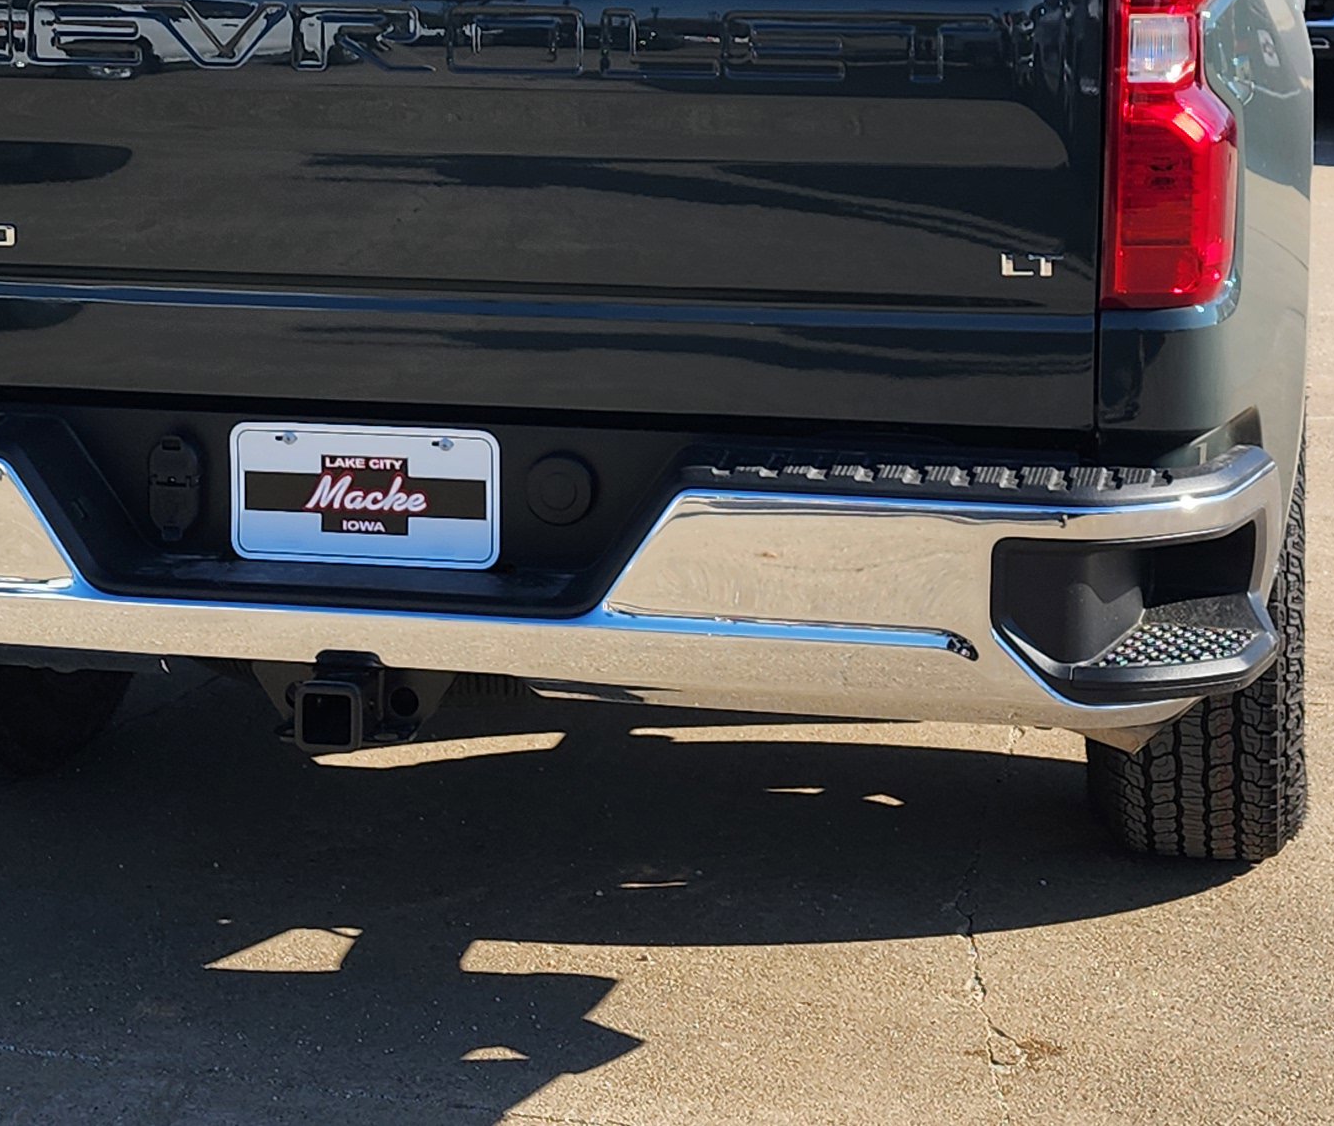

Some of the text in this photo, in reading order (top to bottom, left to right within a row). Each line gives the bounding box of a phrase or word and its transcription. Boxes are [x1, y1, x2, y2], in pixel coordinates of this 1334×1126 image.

[1001, 253, 1065, 277] LT
[324, 456, 403, 471] LAKE CITY
[304, 473, 429, 513] Macke
[341, 519, 386, 533] IOWA
